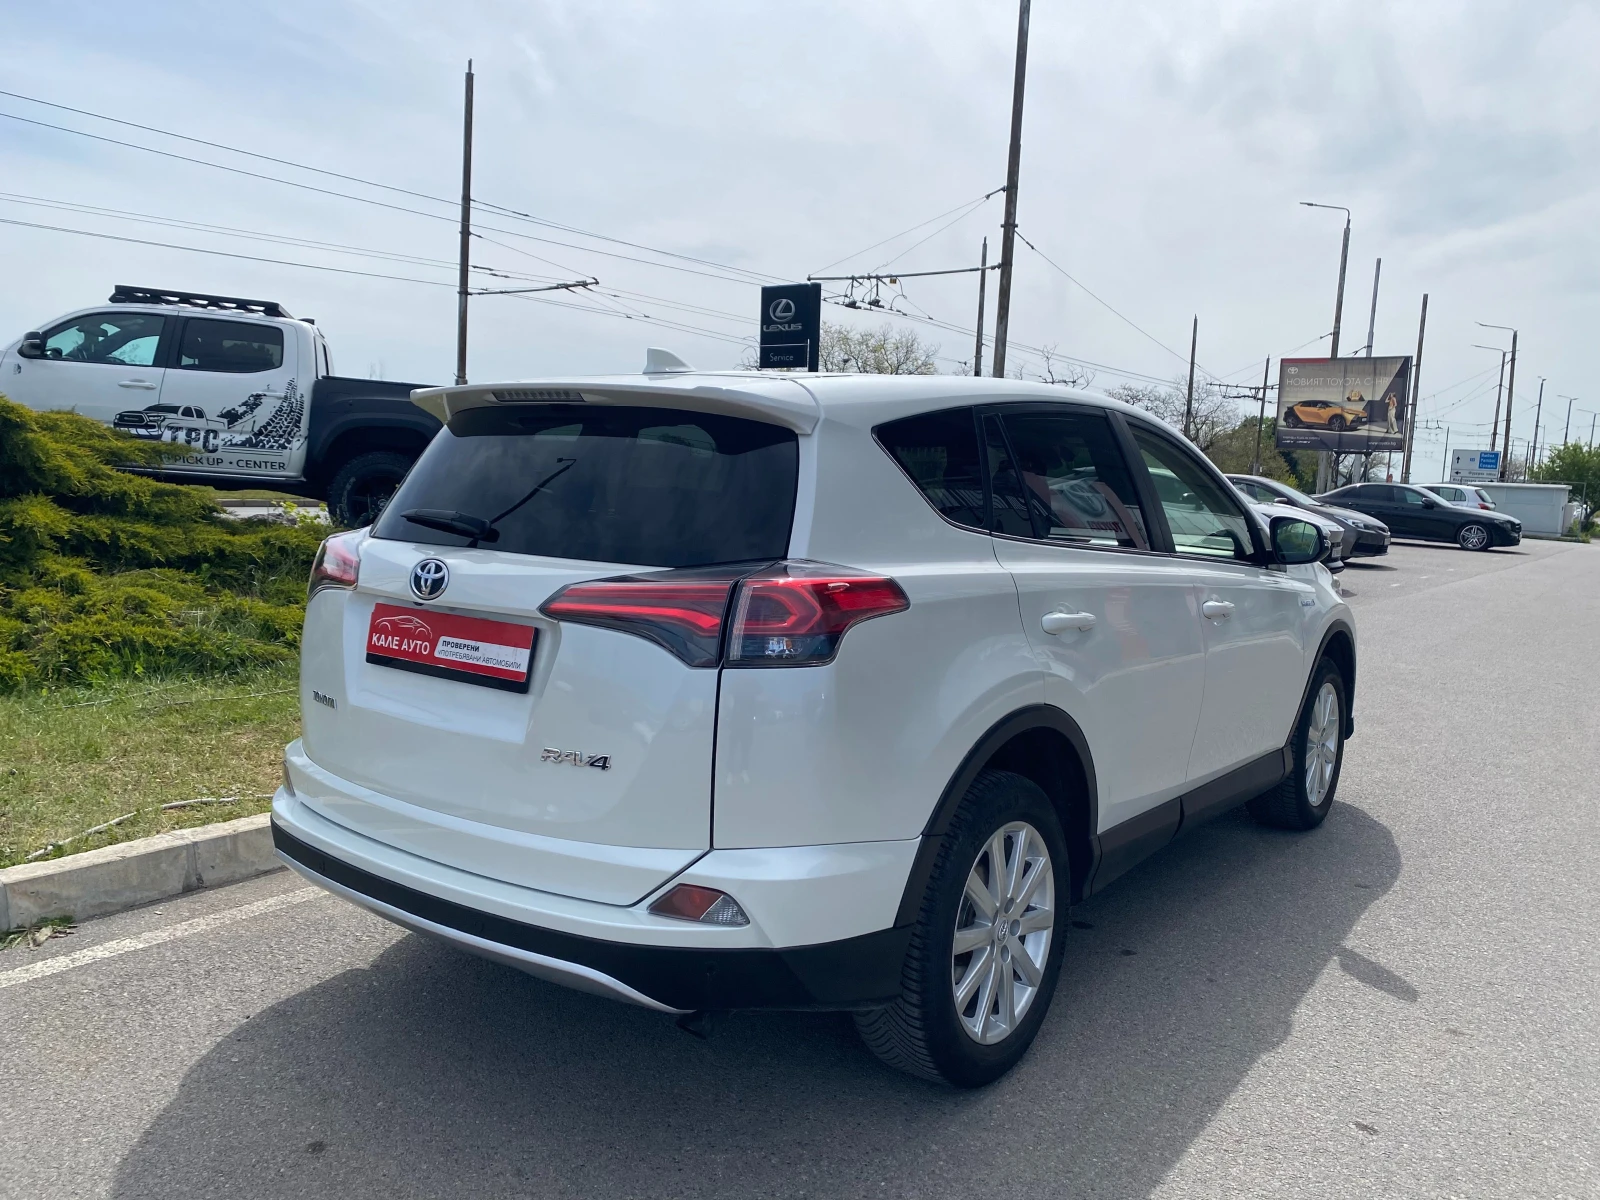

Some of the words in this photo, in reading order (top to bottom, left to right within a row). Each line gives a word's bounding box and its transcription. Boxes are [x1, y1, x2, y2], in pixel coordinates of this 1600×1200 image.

[763, 323, 802, 332] LEXUS
[769, 352, 794, 361] Service
[1286, 377, 1324, 386] НОВИЯТ
[1326, 377, 1361, 386] TOYOTA
[167, 426, 219, 453] TPC
[174, 455, 204, 465] PICK
[206, 457, 224, 466] UP
[236, 459, 286, 470] CENTER
[371, 632, 400, 650] КАЛЕ
[401, 638, 430, 655] АУТО
[442, 640, 480, 652] ПРОВЕРЕНИ
[437, 649, 482, 662] УПОТРЕБЯВАНИ
[481, 657, 522, 670] АВТОМОБИЛИ
[313, 690, 337, 710] TOYOTA
[540, 747, 611, 771] RAV4
